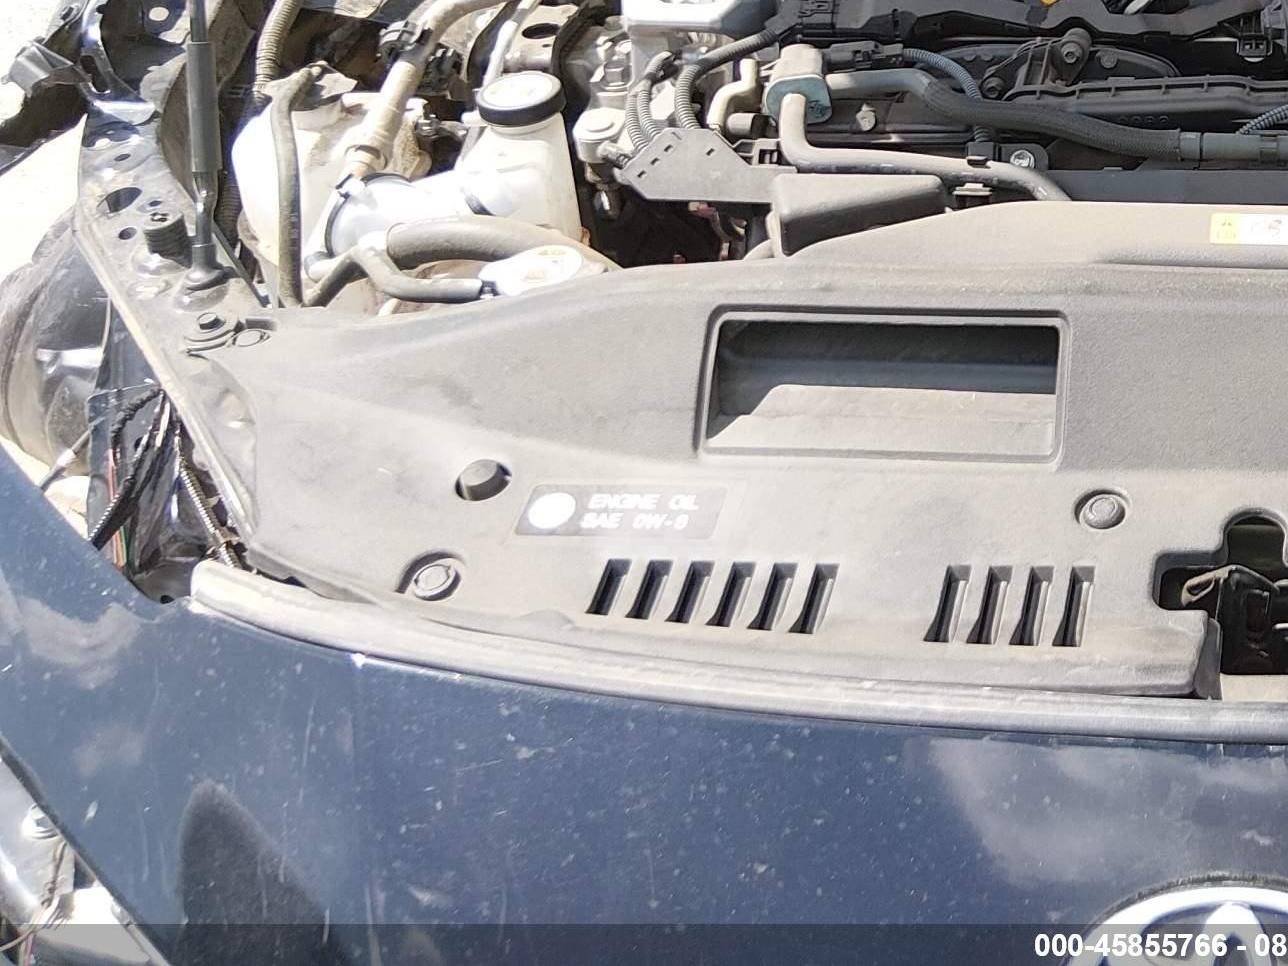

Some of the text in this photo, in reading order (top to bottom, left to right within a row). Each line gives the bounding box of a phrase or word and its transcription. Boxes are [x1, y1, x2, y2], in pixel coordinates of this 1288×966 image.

[588, 493, 700, 511] ENGINE OIL
[579, 512, 624, 529] SAE
